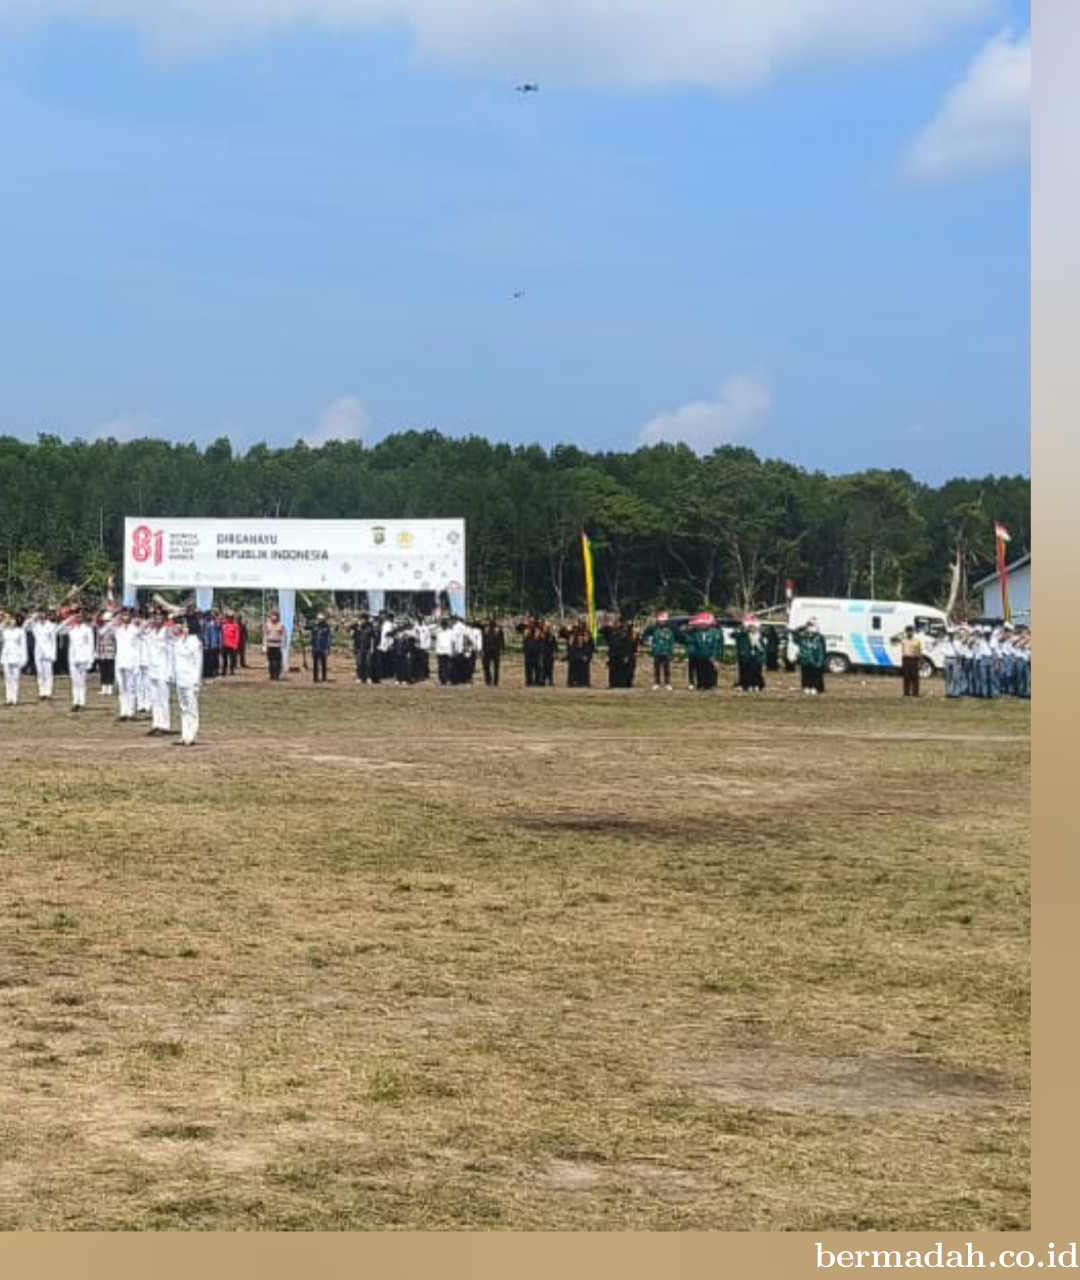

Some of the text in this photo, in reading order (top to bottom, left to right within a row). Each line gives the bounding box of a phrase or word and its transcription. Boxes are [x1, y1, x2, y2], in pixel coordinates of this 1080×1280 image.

[216, 533, 278, 545] DIRGAHAYU
[132, 525, 165, 567] 81
[216, 549, 329, 561] REPUBLIK INDONESIA
